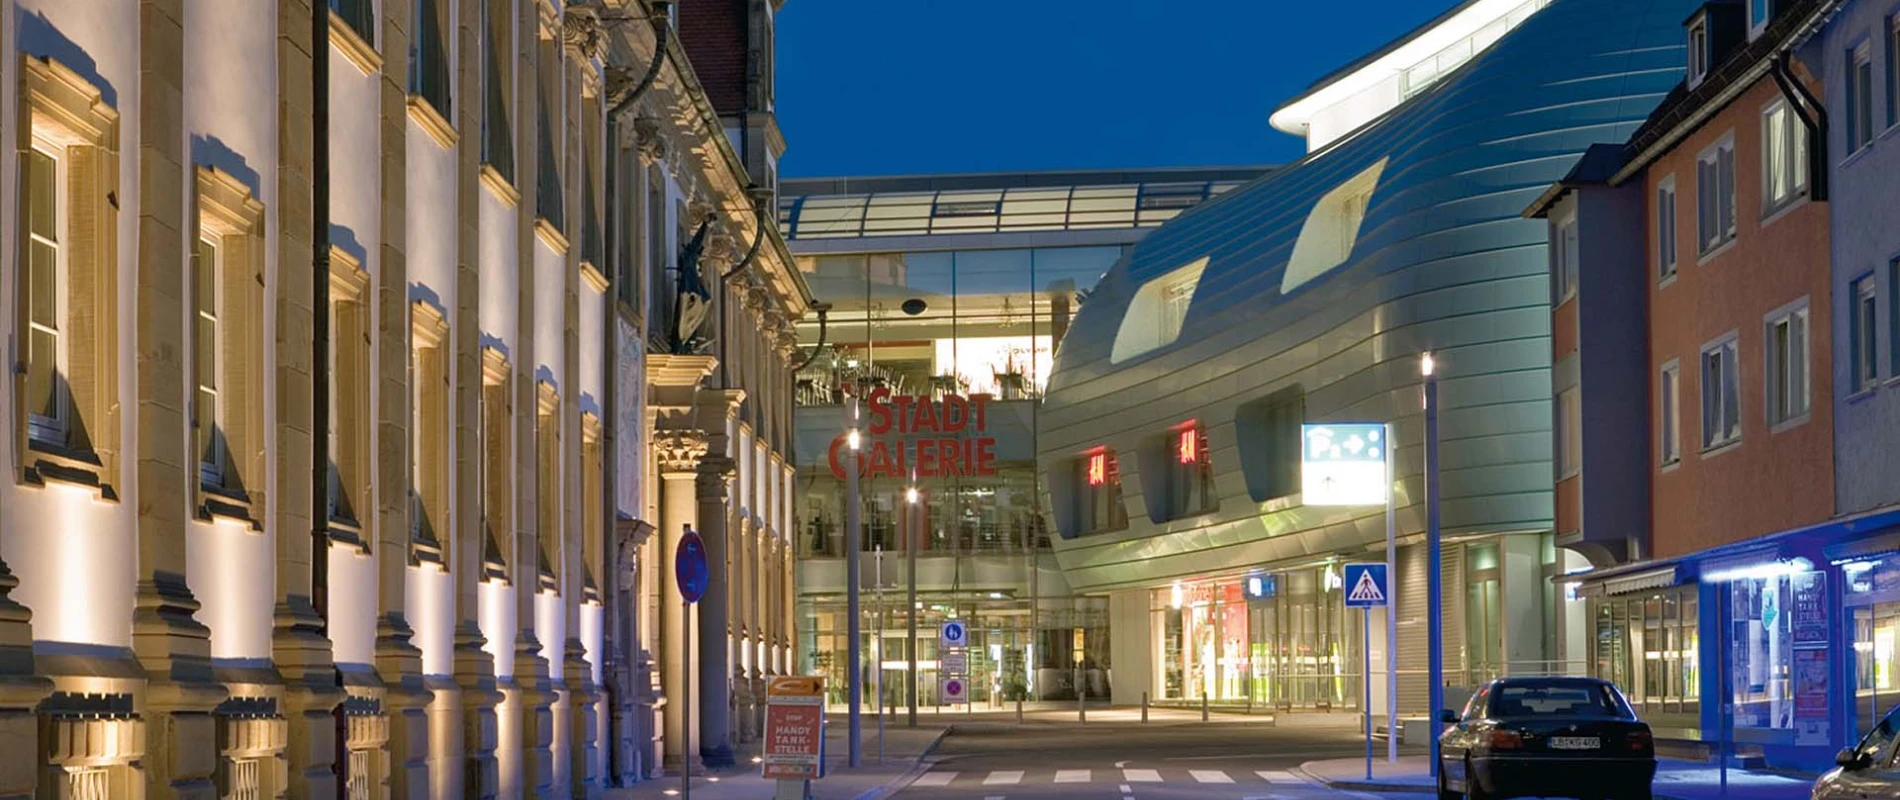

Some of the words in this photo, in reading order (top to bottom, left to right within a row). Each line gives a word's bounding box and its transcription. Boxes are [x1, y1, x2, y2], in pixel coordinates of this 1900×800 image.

[868, 386, 995, 435] STADT
[828, 437, 996, 480] GALERIE
[775, 725, 812, 735] HANDY
[774, 745, 811, 754] STELLE
